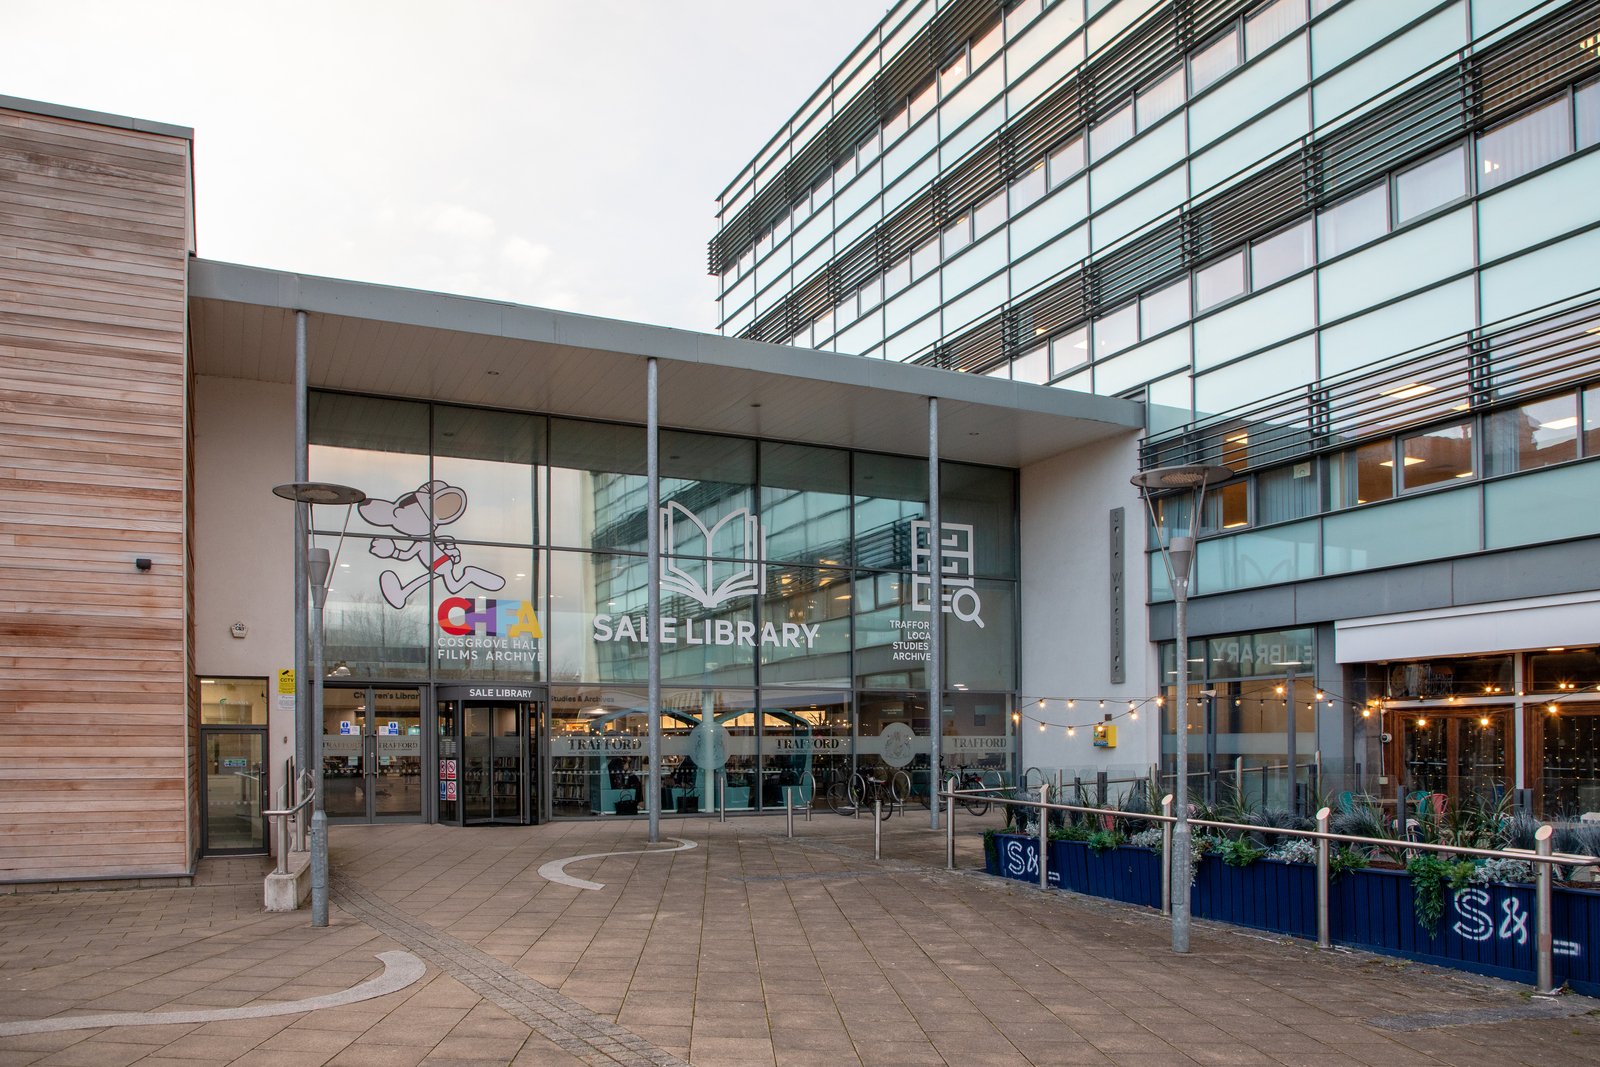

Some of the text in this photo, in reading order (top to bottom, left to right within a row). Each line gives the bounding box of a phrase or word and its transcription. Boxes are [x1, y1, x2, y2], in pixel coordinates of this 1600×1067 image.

[437, 596, 543, 638] CHFA
[889, 620, 930, 630] TRAFFOR
[592, 614, 820, 649] SALE LIBRARY
[907, 631, 931, 640] LOCA
[437, 638, 544, 650] COSGROVE HALL
[892, 641, 929, 651] STUDIES
[437, 649, 544, 662] FILMS ARCHIVE
[892, 652, 931, 661] ARCHIVE
[353, 691, 419, 700] Chren's Librar
[469, 688, 532, 698] SALE LIBRARY
[568, 738, 642, 750] TRAFFORD
[952, 737, 1007, 748] TRAFFORD
